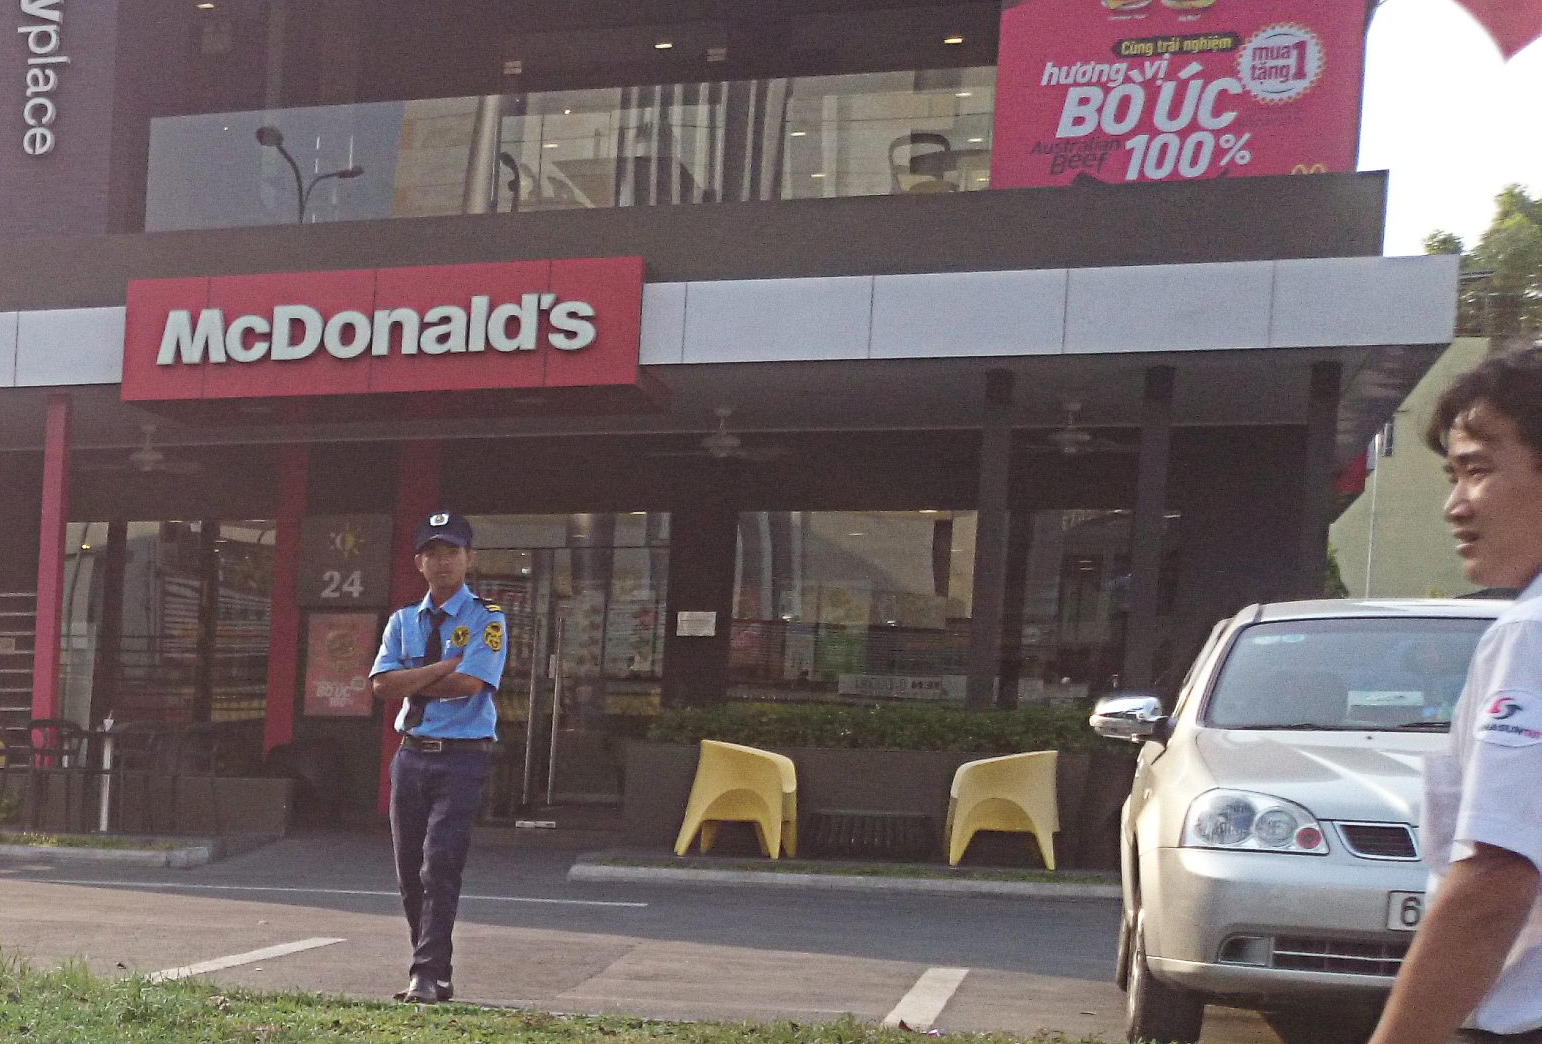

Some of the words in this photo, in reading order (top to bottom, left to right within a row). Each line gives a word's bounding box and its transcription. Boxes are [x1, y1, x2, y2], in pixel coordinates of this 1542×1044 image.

[1041, 61, 1128, 87] hương
[1143, 53, 1171, 87] vị
[1252, 44, 1291, 61] mua
[1292, 40, 1307, 80] 1
[1153, 61, 1244, 133] ÚC
[1049, 150, 1109, 176] Beef
[1125, 130, 1252, 181] 100%
[156, 293, 597, 366] McDonald's
[320, 570, 364, 599] 24
